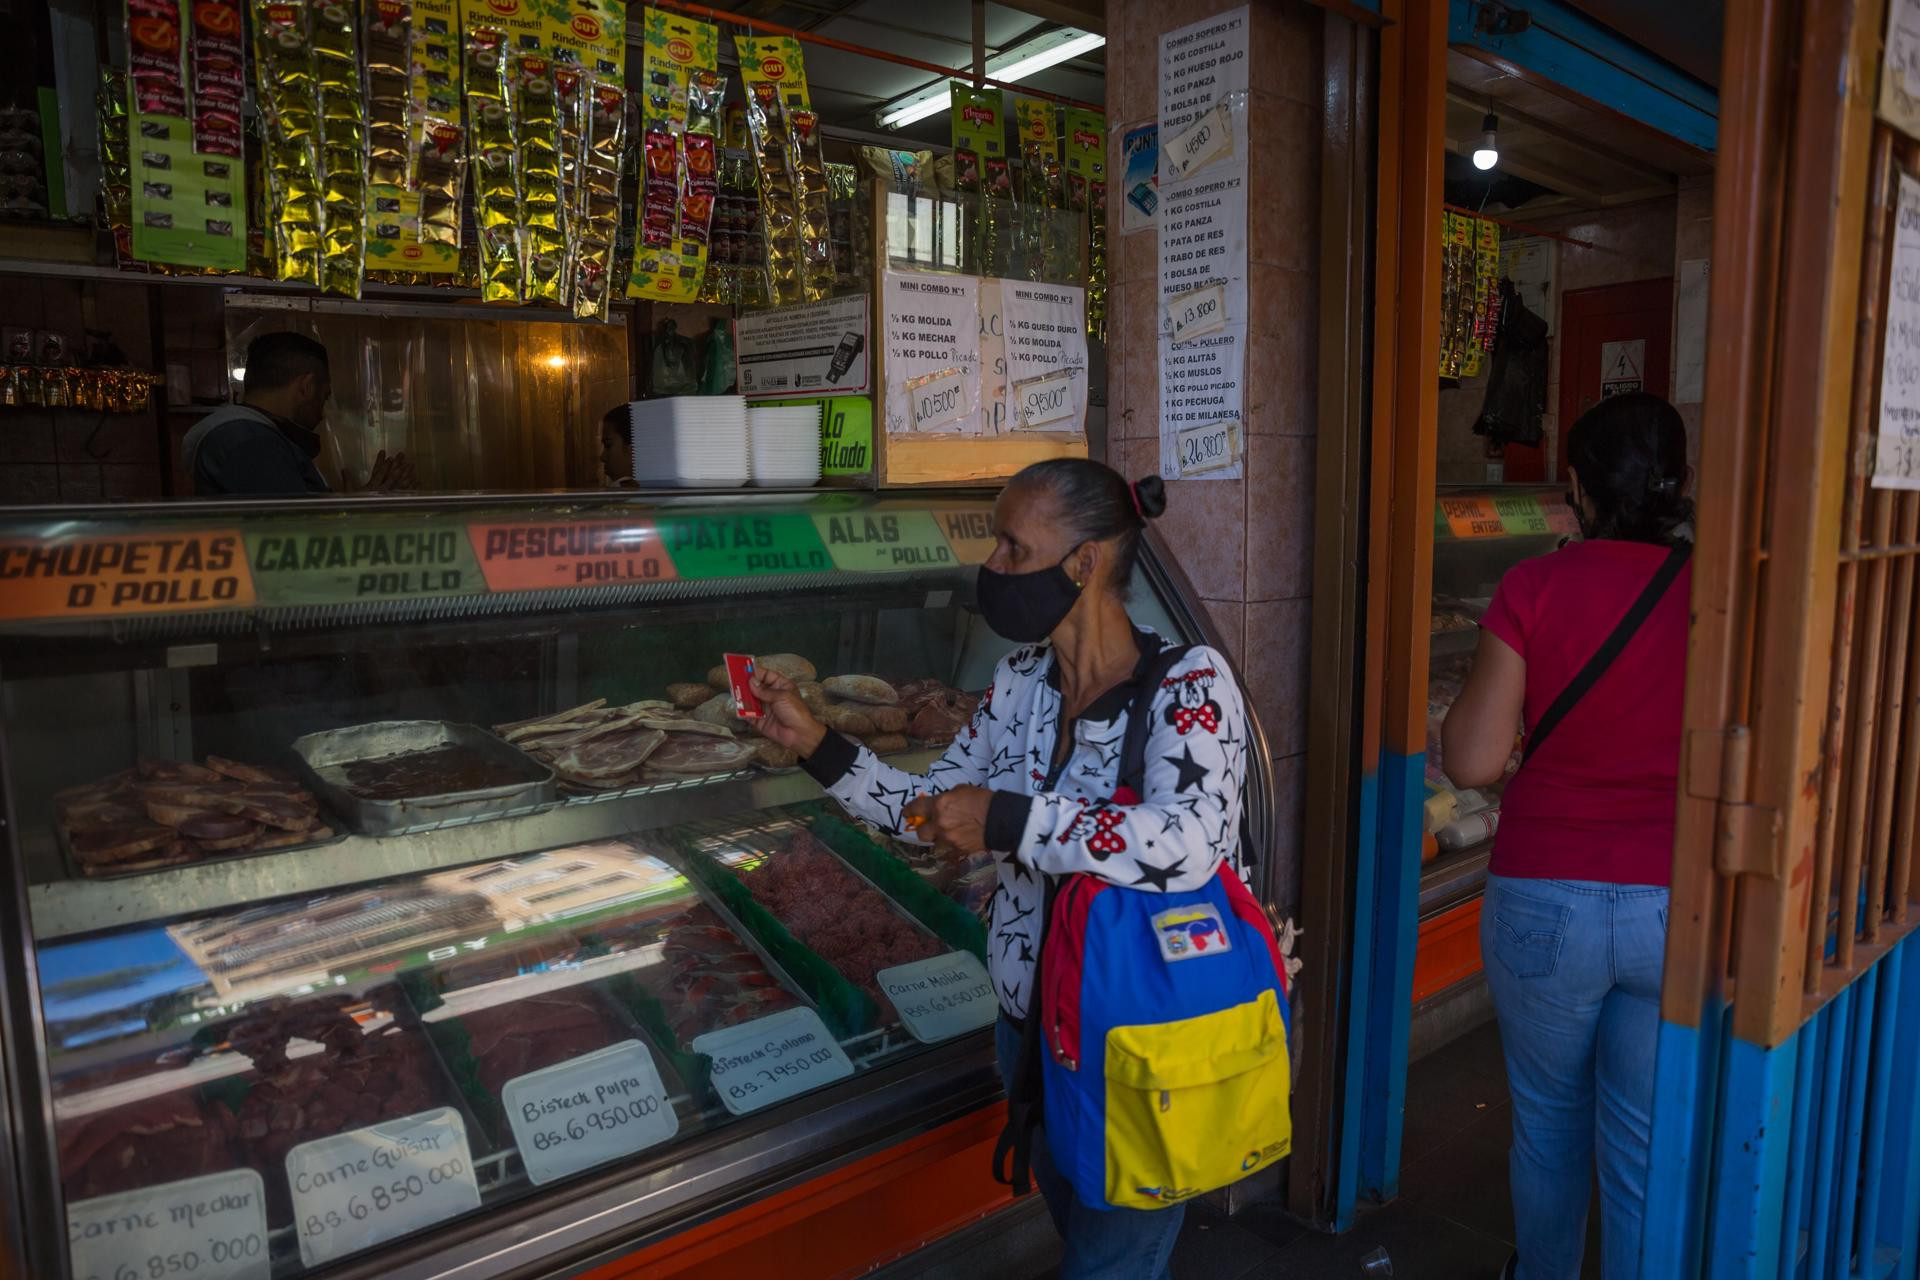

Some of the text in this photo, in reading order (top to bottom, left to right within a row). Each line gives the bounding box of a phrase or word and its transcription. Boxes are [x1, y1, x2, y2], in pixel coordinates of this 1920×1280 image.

[379, 1, 400, 14] GUT
[469, 11, 542, 30] Rinden más!!!
[575, 21, 598, 36] GUT
[1166, 35, 1194, 48] COMBO
[1195, 24, 1227, 39] SOPERO
[552, 31, 588, 49] Rinden
[670, 44, 691, 57] GUT
[1173, 53, 1186, 63] KG
[1187, 41, 1226, 57] COSTILLA
[524, 59, 545, 72] GUT
[650, 57, 682, 72] Rinden
[763, 62, 784, 74] GUT
[1173, 68, 1186, 79] KG
[1187, 59, 1217, 74] HUESO
[1219, 51, 1244, 63] ROJO
[701, 73, 719, 85] GUT
[1173, 85, 1186, 95] KG
[1187, 76, 1216, 90] PANZA
[601, 90, 622, 102] GUT
[757, 87, 773, 96] GUT
[1170, 97, 1198, 110] BOLSA
[1200, 93, 1212, 103] DE
[797, 117, 814, 126] GUT
[1164, 115, 1192, 127] HUESO
[435, 127, 457, 140] GUT
[1128, 132, 1158, 152] PUNT
[1195, 182, 1225, 194] SOPERO
[1170, 205, 1183, 215] KG
[1185, 198, 1221, 212] COSTILLA
[1170, 222, 1183, 231] KG
[1185, 215, 1212, 228] PANZA
[1170, 236, 1192, 247] PATA
[1194, 234, 1206, 242] DE
[1207, 229, 1224, 240] RES
[1164, 246, 1226, 264] 1 RABO DE RES
[1170, 267, 1197, 278] BOLSA
[1199, 265, 1210, 273] DE
[900, 281, 919, 291] MINI
[921, 283, 950, 294] COMBO
[1164, 283, 1192, 294] HUESO
[1015, 290, 1032, 299] MINI
[1034, 292, 1058, 302] COMBO
[901, 315, 915, 324] KG
[918, 316, 952, 327] MOLIDA
[1017, 321, 1030, 330] KG
[1031, 323, 1055, 332] QUESO
[1057, 324, 1078, 334] DURO
[902, 332, 916, 341] KG
[918, 334, 956, 343] MECHAR
[1018, 336, 1030, 346] KG
[1031, 338, 1062, 348] MOLIDA
[1200, 336, 1235, 347] POLLERO
[903, 349, 917, 359] KG
[919, 350, 948, 360] POLLO
[1019, 353, 1031, 362] KG
[1032, 354, 1058, 364] POLLO
[1173, 355, 1186, 365] KG
[1187, 353, 1217, 364] ALITAS
[1173, 370, 1186, 379] KG
[1187, 367, 1222, 377] MUSLOS
[1173, 384, 1186, 393] KG
[1187, 383, 1208, 392] POLLO
[1210, 381, 1236, 390] PICADO
[1165, 396, 1224, 408] 1 KG PECHUGA
[1171, 413, 1183, 421] KG
[1185, 413, 1196, 421] DE
[1198, 410, 1240, 420] MILANESA
[1443, 502, 1485, 518] PERNIL
[827, 515, 900, 545] ALAS
[1471, 520, 1503, 534] ENTERO
[672, 518, 773, 552] PATAS
[0, 535, 235, 579] CHUPETAS
[254, 530, 458, 572] CARAPACHO
[891, 545, 950, 566] POLLO
[746, 550, 825, 573] POLLO
[574, 558, 660, 584] POLLO
[355, 569, 462, 596] POLLO
[111, 575, 240, 607] POLLO
[888, 970, 968, 996] Carne Molida
[595, 1077, 640, 1105] Pulpa
[728, 1079, 764, 1100] Bs.
[532, 1095, 659, 1151] Bs. 6.950.000
[295, 1132, 442, 1195] Carne Guisar
[348, 1157, 464, 1221] 6.850.000
